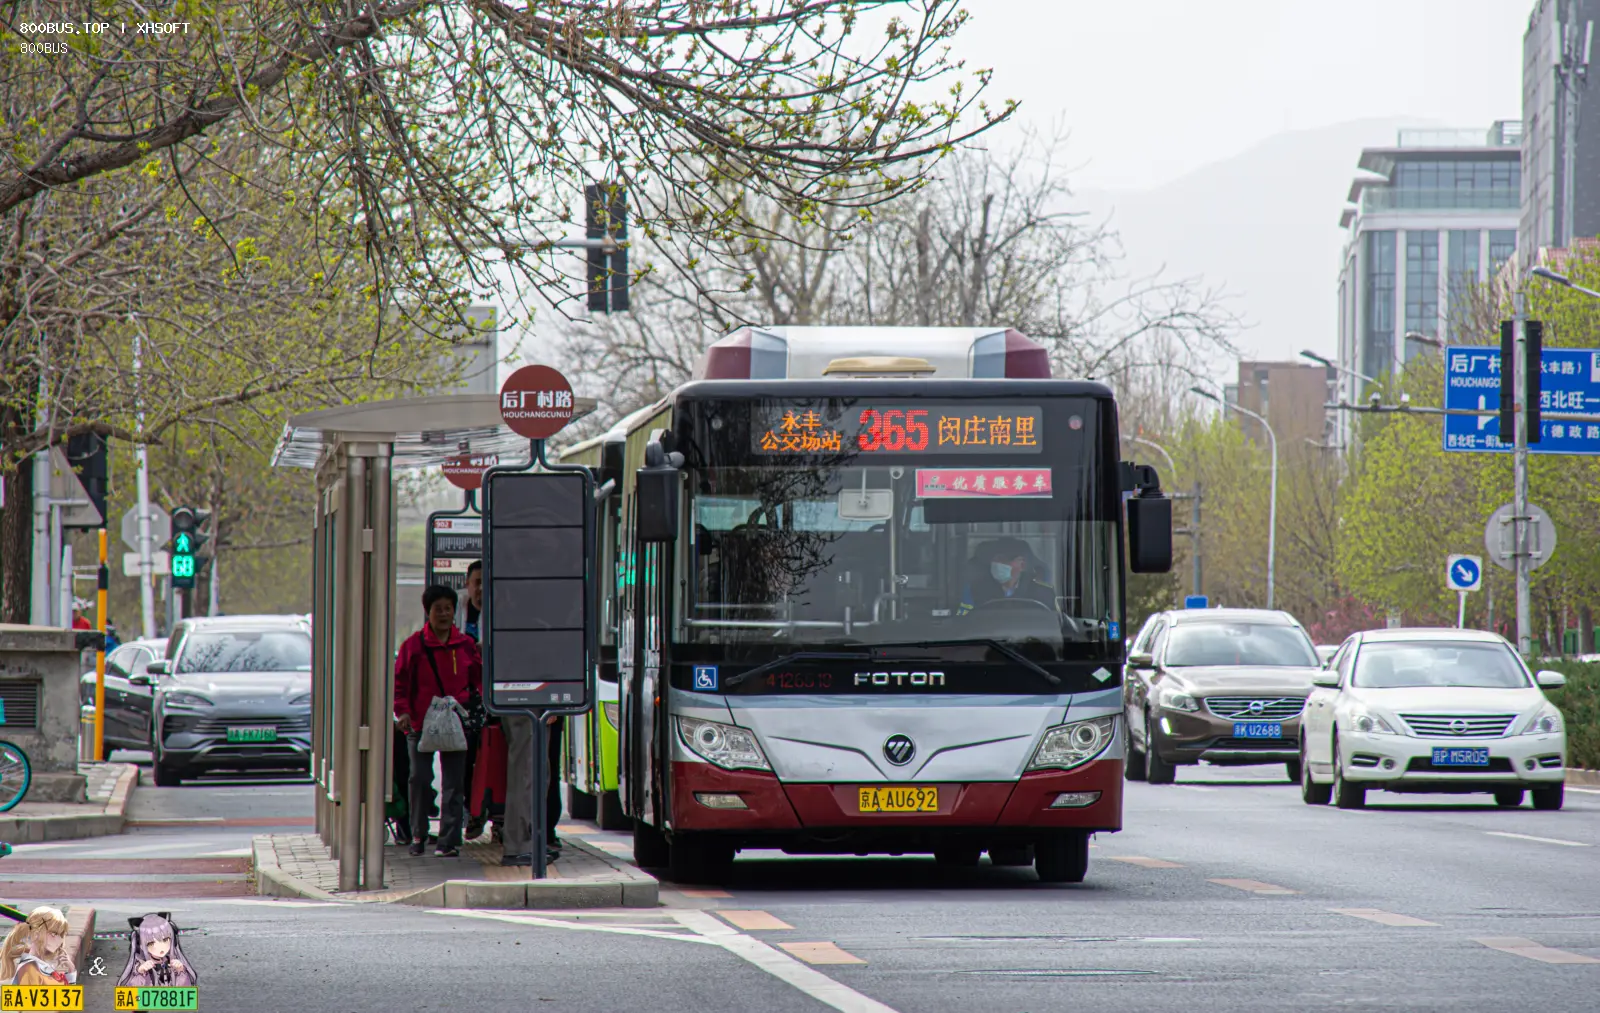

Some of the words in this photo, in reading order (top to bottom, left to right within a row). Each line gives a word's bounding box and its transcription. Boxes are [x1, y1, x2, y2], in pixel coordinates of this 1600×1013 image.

[502, 390, 572, 408] 后厂村路
[780, 410, 822, 431] 永丰
[859, 409, 929, 450] 365
[938, 415, 1037, 446] 闵庄南里
[760, 430, 842, 451] 公交场站
[951, 474, 1047, 491] 优质服务车
[854, 672, 945, 686] FOTON
